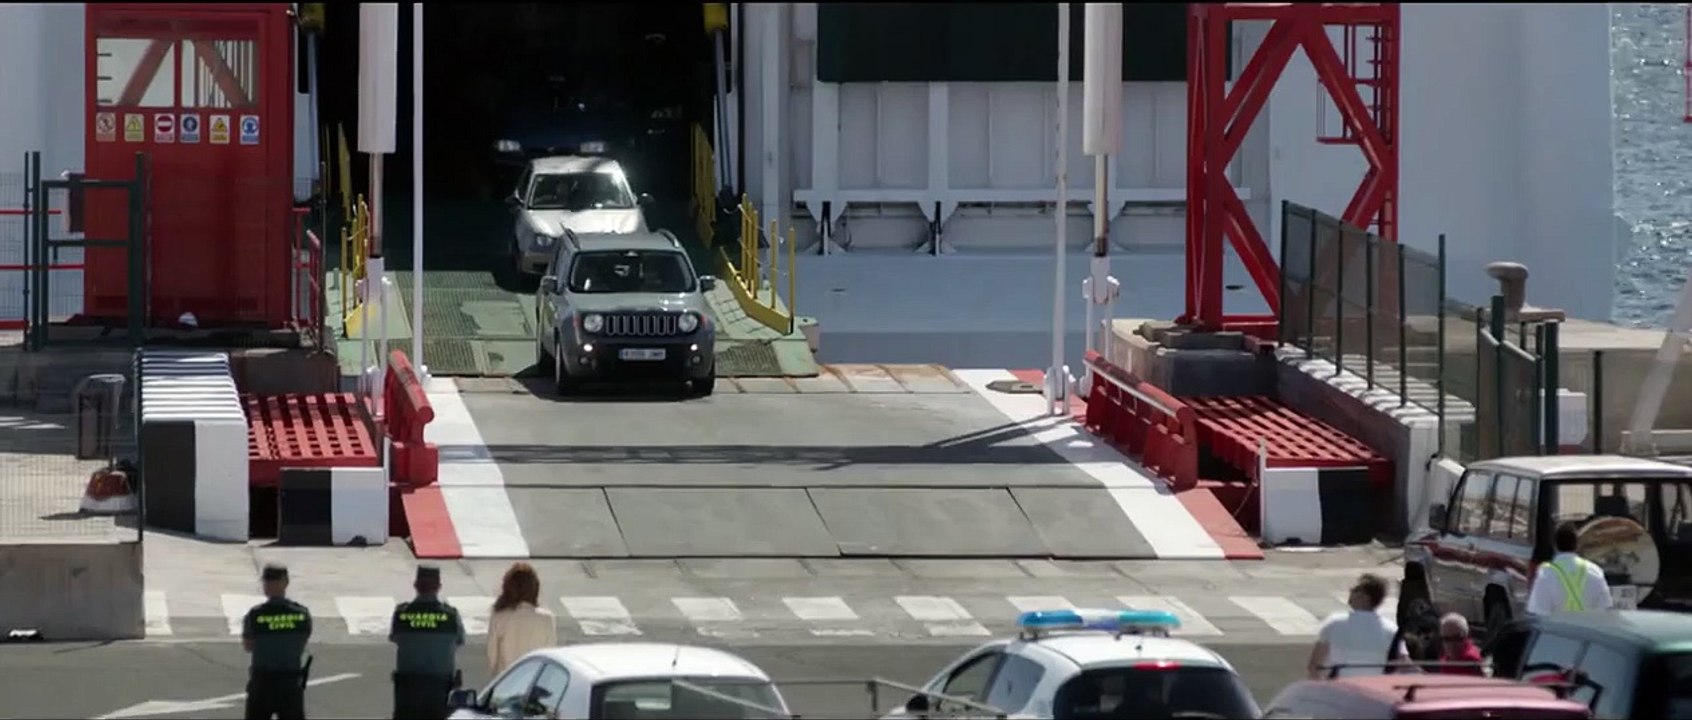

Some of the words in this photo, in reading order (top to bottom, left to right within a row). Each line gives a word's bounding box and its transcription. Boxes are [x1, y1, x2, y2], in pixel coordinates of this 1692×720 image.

[256, 613, 305, 623] GUARDIA
[399, 613, 448, 621] GUARDIA
[268, 622, 296, 630] CIVIL
